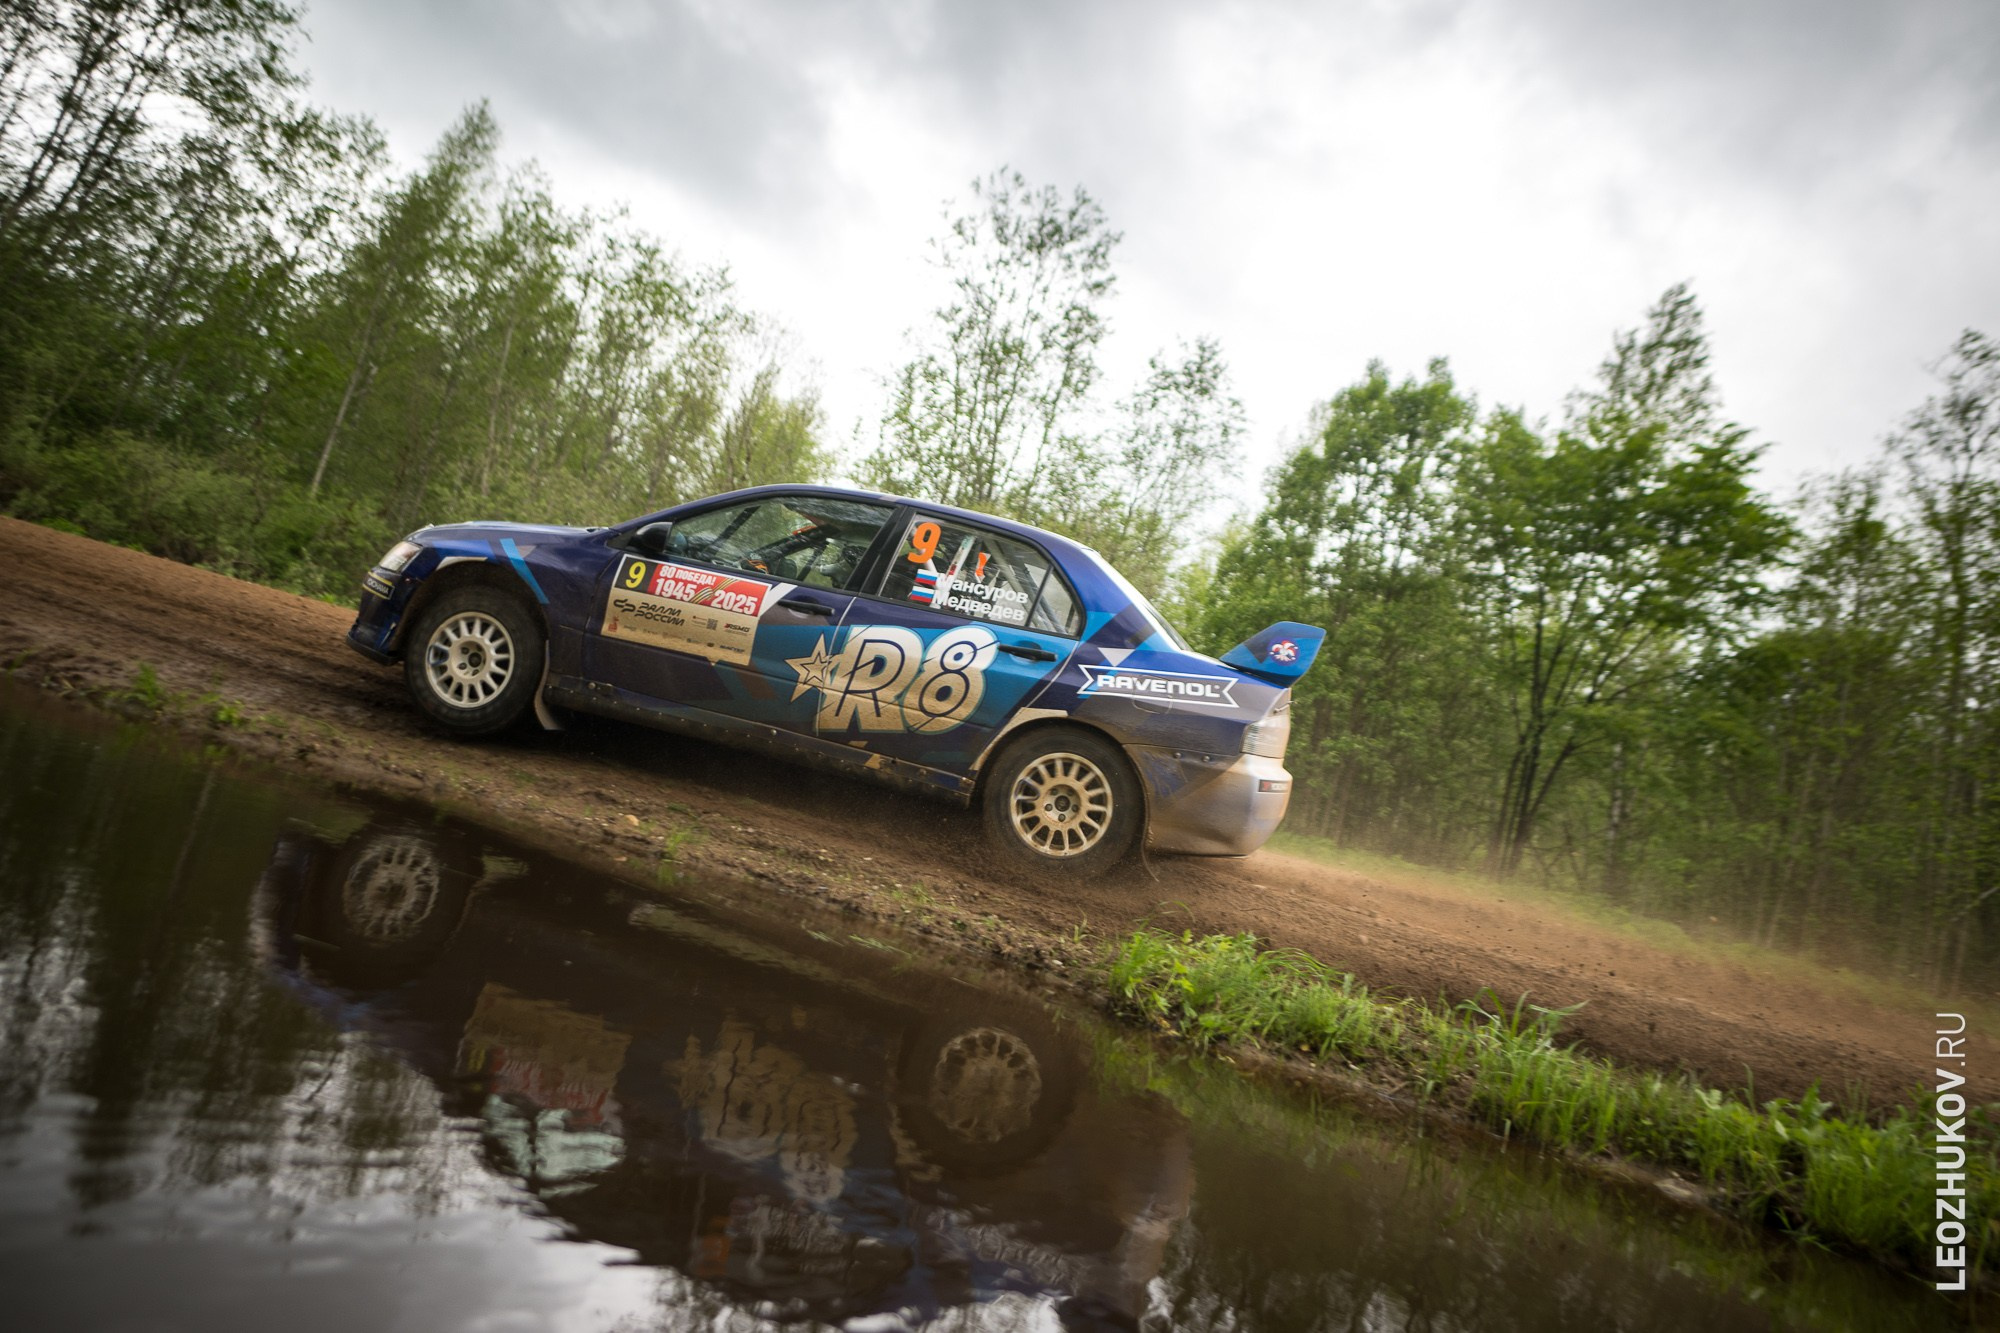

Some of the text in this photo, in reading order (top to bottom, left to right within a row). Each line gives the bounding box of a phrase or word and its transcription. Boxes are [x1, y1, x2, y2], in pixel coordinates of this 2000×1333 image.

[907, 522, 942, 564] 9
[625, 561, 647, 589] 9
[659, 565, 717, 586] 80 ПОБЕДА!
[640, 602, 682, 617] РАЛЛИ
[655, 578, 758, 615] 1945 2025
[931, 589, 1026, 622] Медведев
[634, 611, 685, 627] РОССИИ
